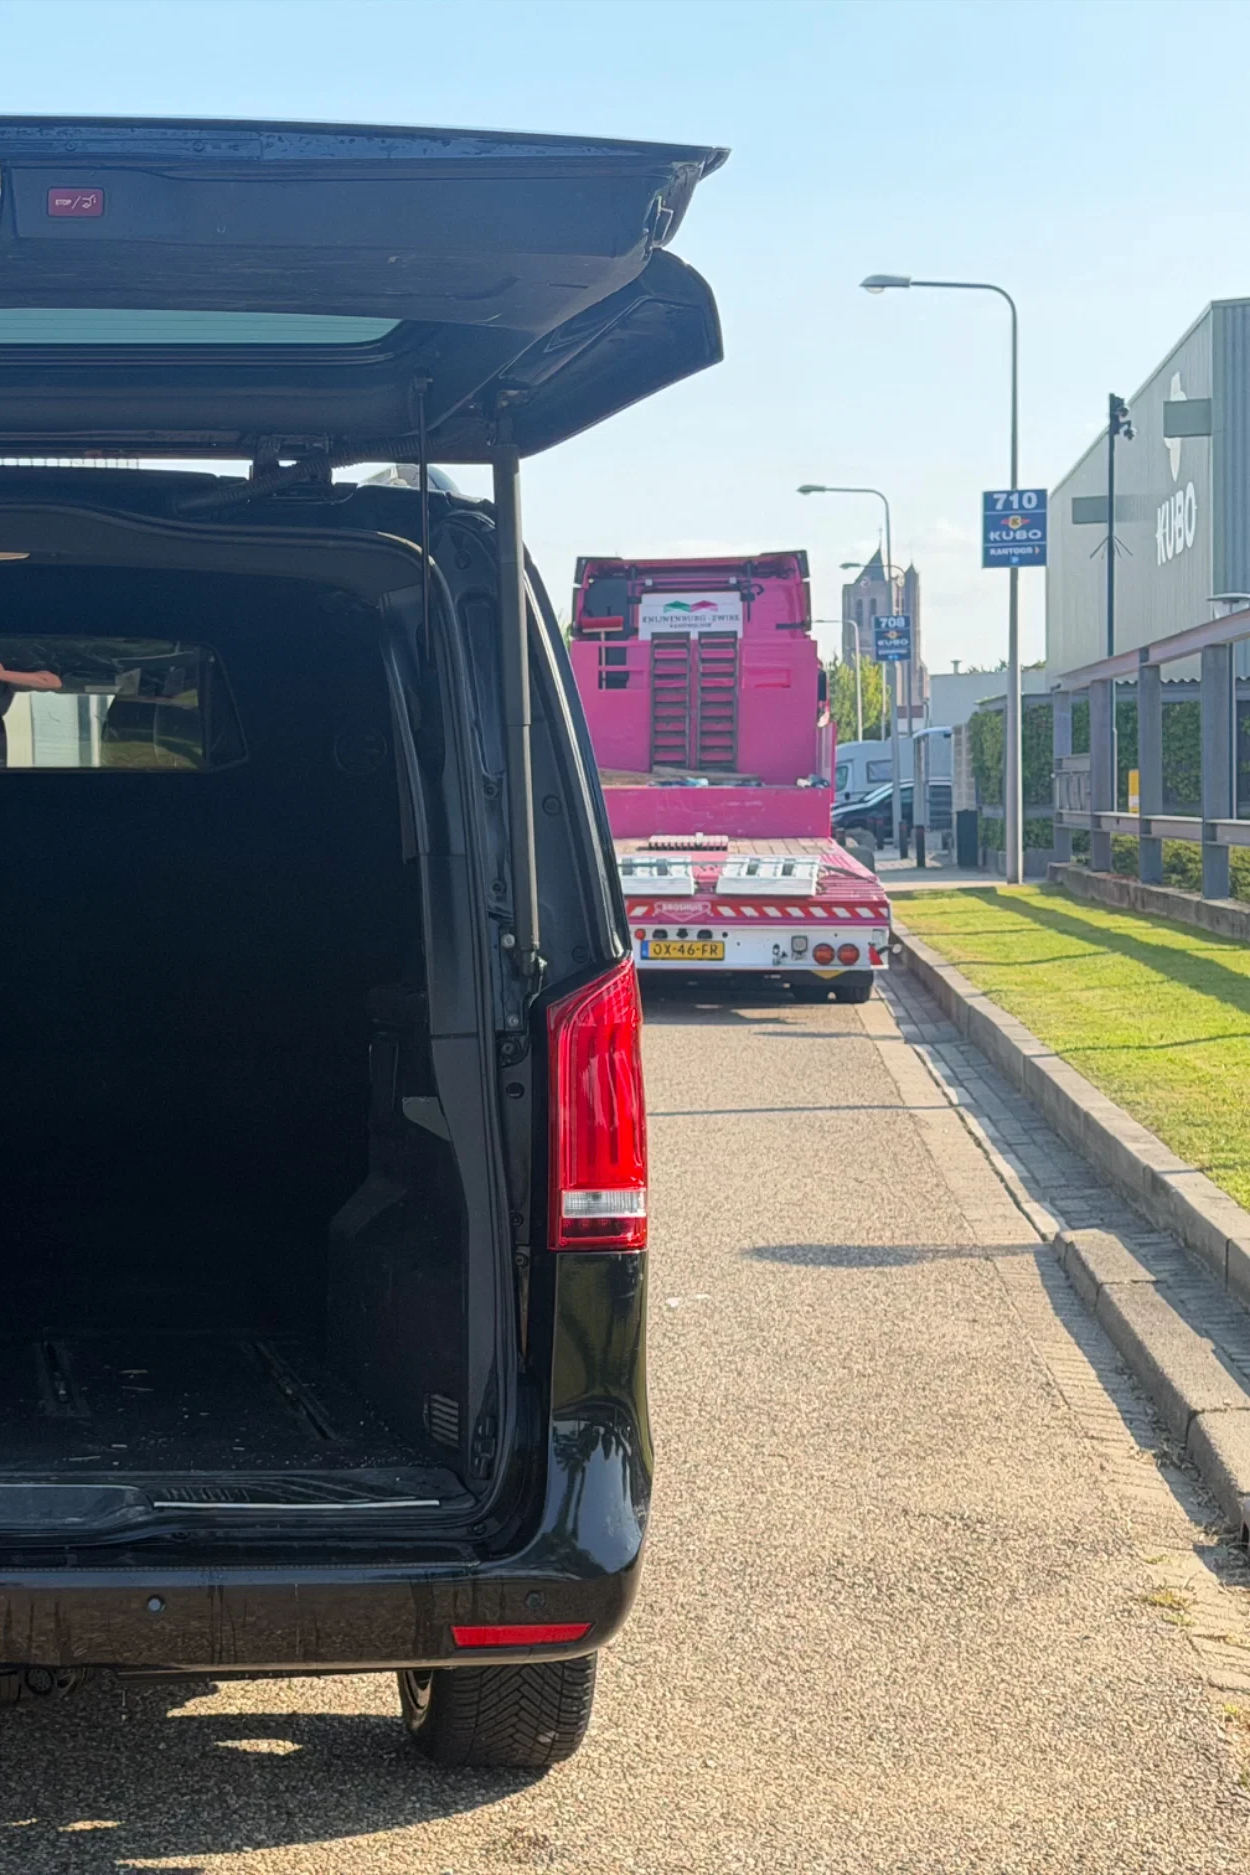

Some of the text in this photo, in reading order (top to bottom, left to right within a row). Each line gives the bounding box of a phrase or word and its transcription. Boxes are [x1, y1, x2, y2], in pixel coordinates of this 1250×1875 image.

[993, 491, 1038, 510] 710
[1155, 481, 1197, 566] KUBO
[989, 529, 1042, 541] KUBO
[879, 617, 905, 628] 708
[653, 943, 718, 956] OX-46-FR
